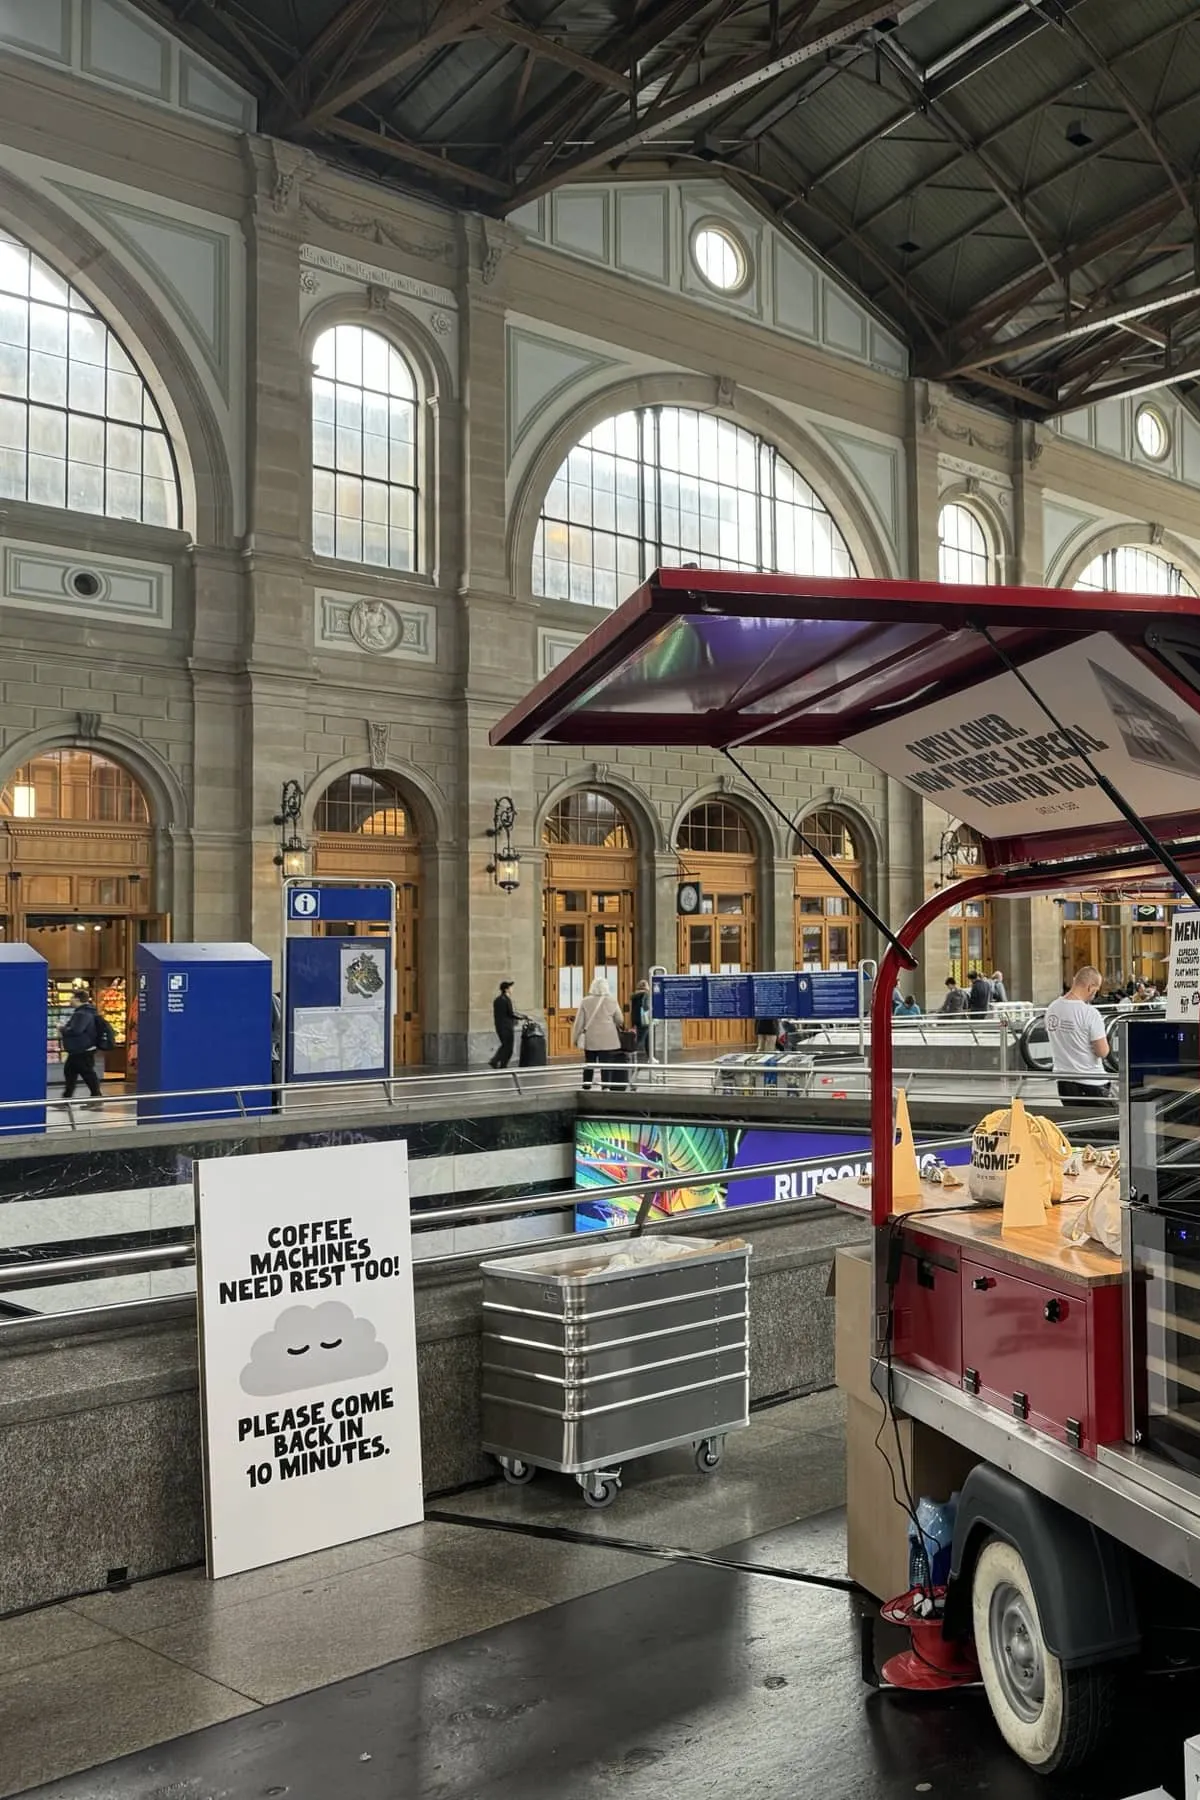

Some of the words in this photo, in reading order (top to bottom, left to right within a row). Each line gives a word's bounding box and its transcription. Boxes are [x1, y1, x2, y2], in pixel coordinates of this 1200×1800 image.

[905, 728, 969, 764] OATLY
[1003, 746, 1037, 769] A
[1017, 724, 1110, 766] SPECIAL
[905, 768, 956, 793] NOW
[938, 750, 1020, 785] THERE'S
[962, 780, 1028, 807] TRAIN
[1008, 773, 1060, 798] FOR
[268, 1217, 352, 1248] COFFEE
[250, 1238, 371, 1275] MACHINES
[219, 1273, 283, 1304] NEED
[290, 1264, 346, 1293] REST
[350, 1256, 400, 1283] TOO!
[238, 1401, 326, 1442] PLEASE
[331, 1387, 394, 1420] COME
[274, 1423, 335, 1458] BACK
[339, 1416, 363, 1443] IN
[246, 1462, 272, 1488] 10
[279, 1435, 391, 1480] MINUTES.
